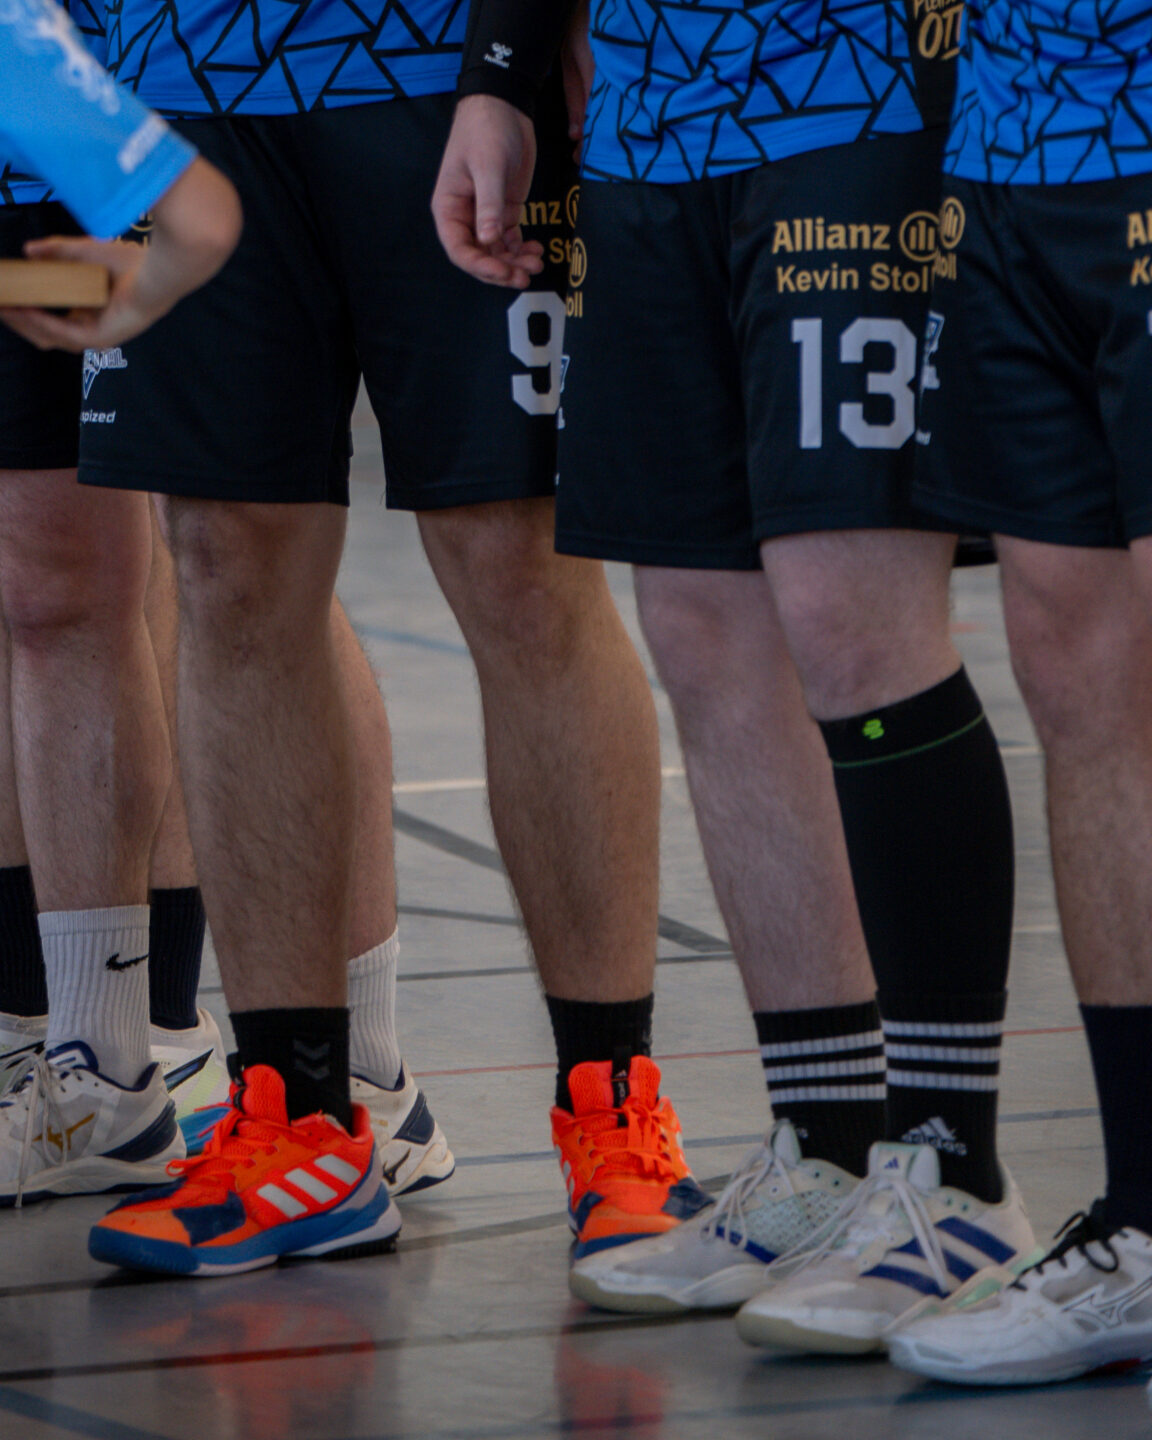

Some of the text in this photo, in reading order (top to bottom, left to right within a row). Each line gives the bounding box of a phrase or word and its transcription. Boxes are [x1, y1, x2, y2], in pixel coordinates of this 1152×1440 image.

[771, 217, 891, 254] Allianz
[777, 263, 859, 293] Kevin
[507, 290, 567, 416] 9
[791, 317, 917, 450] 13
